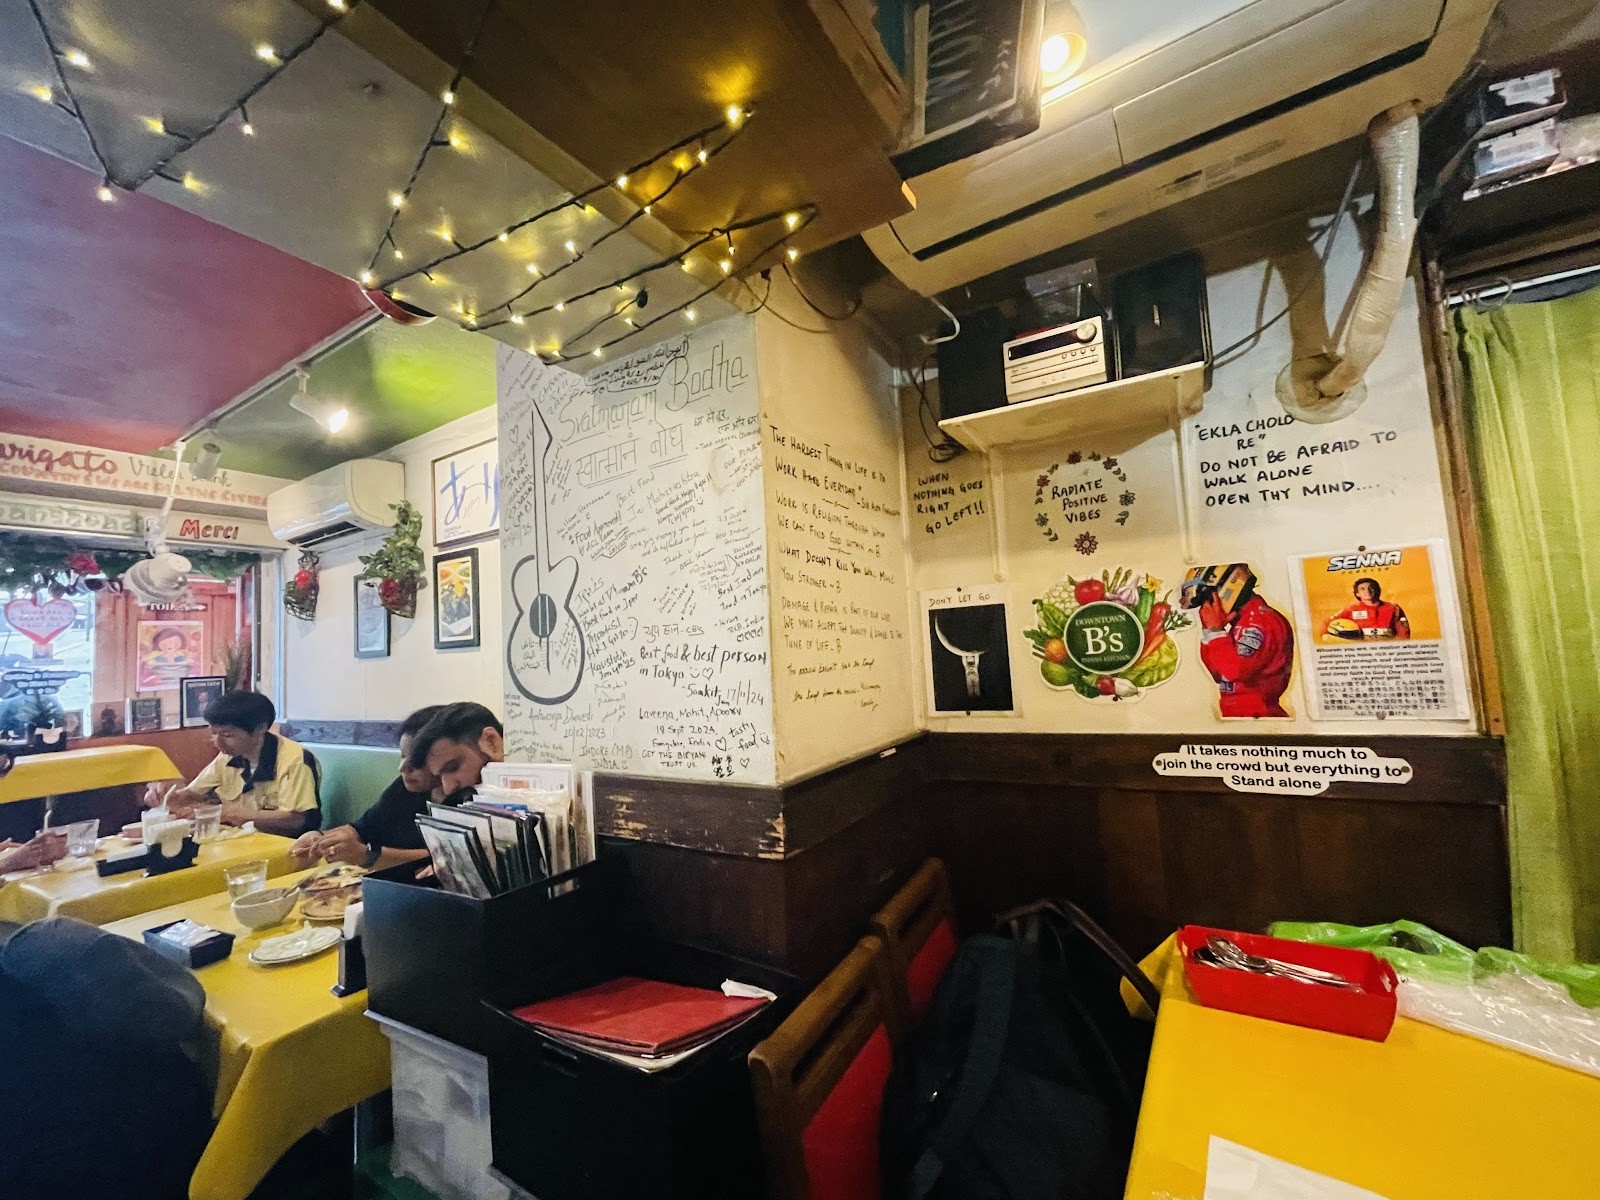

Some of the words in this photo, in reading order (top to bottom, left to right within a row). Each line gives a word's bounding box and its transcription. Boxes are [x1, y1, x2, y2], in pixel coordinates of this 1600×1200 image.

[1199, 460, 1222, 474] DO
[1228, 454, 1259, 470] NOT
[1266, 449, 1288, 465] BE
[1295, 438, 1361, 460] AFRAID
[1370, 430, 1399, 445] TO
[775, 455, 798, 479] WORK
[1204, 473, 1248, 489] WALK
[1256, 463, 1314, 483] ALONE
[917, 472, 950, 487] WHEN
[1051, 478, 1104, 500] RADIATE
[776, 490, 797, 509] WORK
[912, 485, 955, 501] NOTHING
[959, 480, 984, 495] GOES
[1205, 492, 1251, 508] OPEN
[1258, 487, 1292, 502] THY
[916, 501, 951, 514] RIGHT
[1062, 492, 1109, 511] POSITIVE
[777, 513, 789, 530] WE
[1064, 508, 1102, 525] VIBES
[179, 518, 239, 540] Merci
[924, 521, 943, 535] GO
[778, 541, 800, 560] WHAT
[1326, 549, 1402, 572] SENNA
[958, 593, 972, 604] LET
[978, 592, 991, 602] GO
[783, 615, 795, 630] WE
[1075, 614, 1127, 627] DOWNTOWN
[1082, 625, 1124, 655] B's
[680, 643, 693, 662] &
[693, 644, 720, 663] best
[719, 650, 768, 674] person
[640, 666, 649, 677] in
[652, 664, 686, 688] Tokyo
[659, 750, 673, 760] THE
[1186, 744, 1197, 756] It
[1198, 745, 1238, 757] takes
[1241, 745, 1298, 760] nothing
[1302, 748, 1347, 760] much
[1350, 748, 1368, 761] to
[1161, 758, 1187, 771] join
[1190, 759, 1213, 771] the
[1215, 760, 1262, 773] crowd
[1264, 761, 1291, 774] but
[1293, 764, 1381, 779] everything
[1384, 765, 1403, 777] to
[1231, 774, 1276, 788] Stand
[1278, 776, 1323, 790] alone
